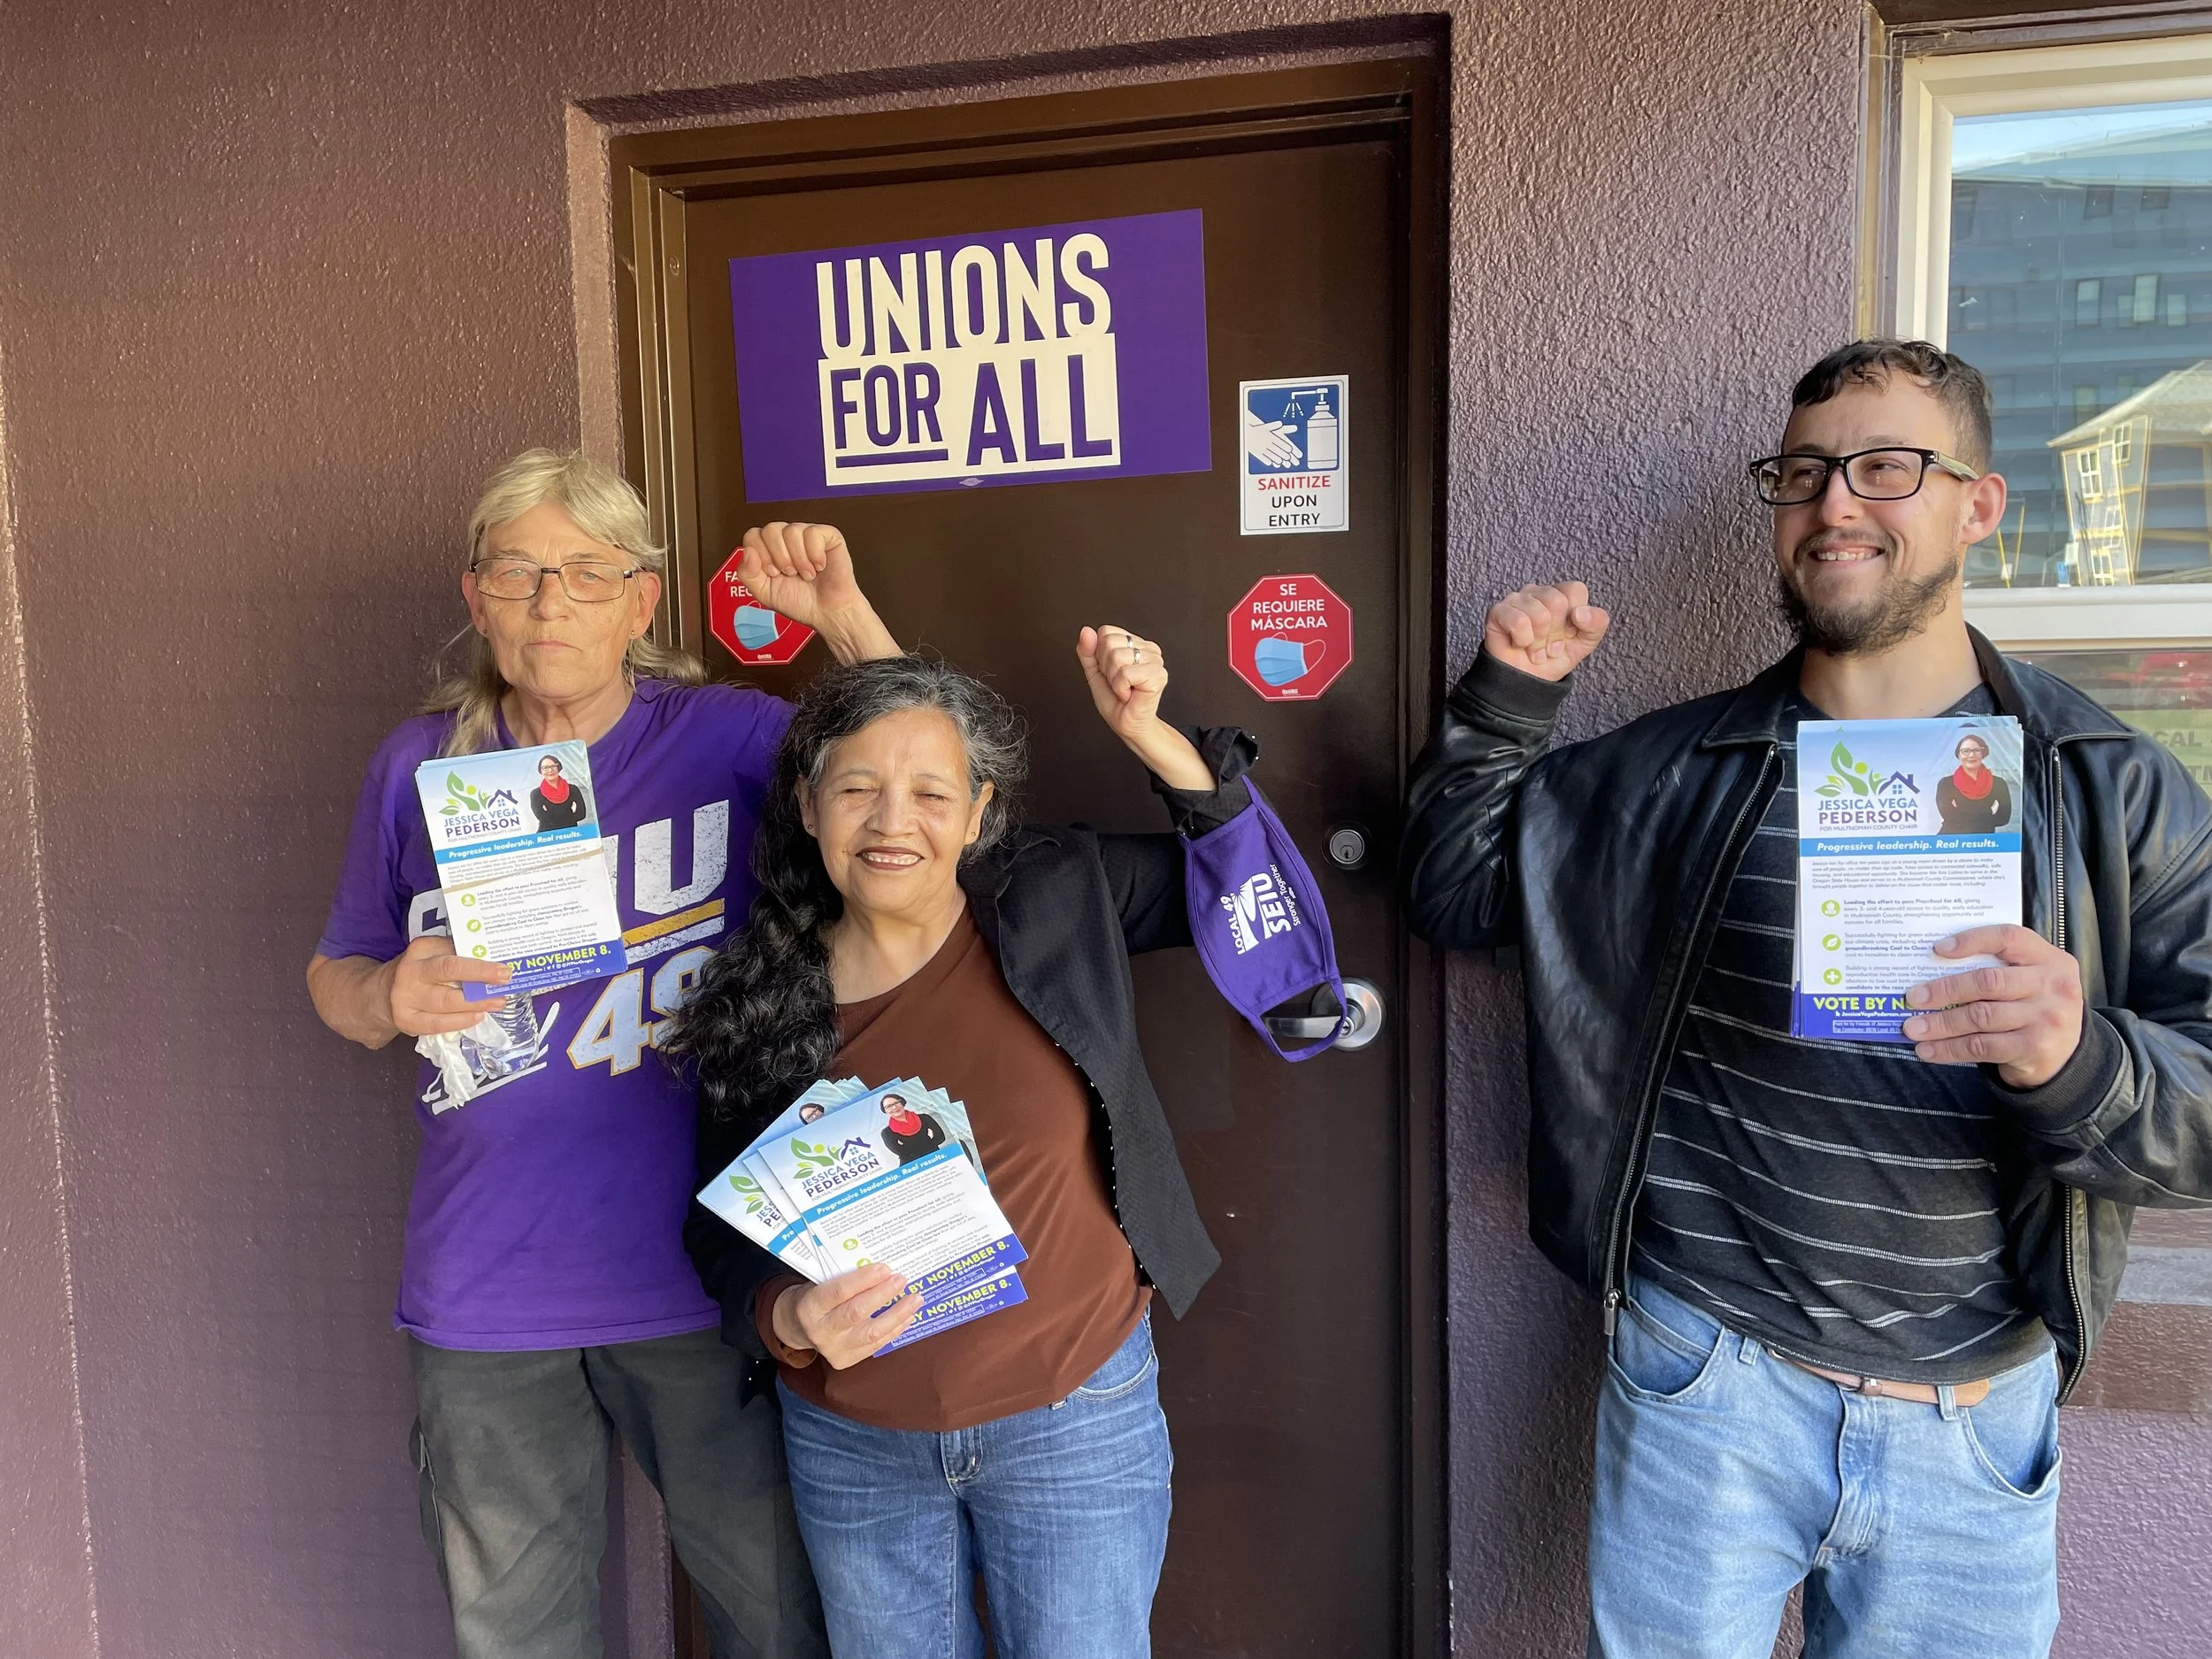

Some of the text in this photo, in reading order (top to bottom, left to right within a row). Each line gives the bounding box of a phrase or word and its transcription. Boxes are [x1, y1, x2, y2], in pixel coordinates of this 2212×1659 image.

[816, 233, 1111, 359] UNIONS
[830, 354, 1113, 466] FOR ALL
[1258, 475, 1331, 490] SANITIZE
[1271, 495, 1317, 508] UPON
[1269, 513, 1320, 526] ENTRY
[1279, 583, 1297, 595] SE
[1253, 599, 1325, 614] REQUIERE
[1251, 615, 1327, 631] MÁSCARA
[1817, 798, 1918, 810] JESSICA VEGA
[444, 808, 519, 827] JESSICA VEGA
[446, 817, 520, 837] PEDERSON
[1819, 810, 1917, 824] PEDERSON
[449, 831, 582, 858] Progressive leadership. Real results.
[1816, 838, 2000, 853] Progressive leadership. Real results.
[1251, 872, 1292, 933] SEIU
[1270, 864, 1302, 926] Stronger Together
[1220, 895, 1246, 955] LOCAL 49
[506, 945, 611, 972] BY NOVEMBER 8.
[1813, 997, 1859, 1010] VOTE
[1865, 997, 1887, 1010] BY
[803, 1151, 875, 1189] JESSICA VEGA
[806, 1158, 879, 1197] PEDERSON
[817, 1154, 948, 1215] Progressive leadership. Real results.
[909, 1240, 1010, 1294] BY NOVEMBER 8.
[927, 1284, 997, 1317] NOVEMBER
[999, 1279, 1011, 1289] 8.
